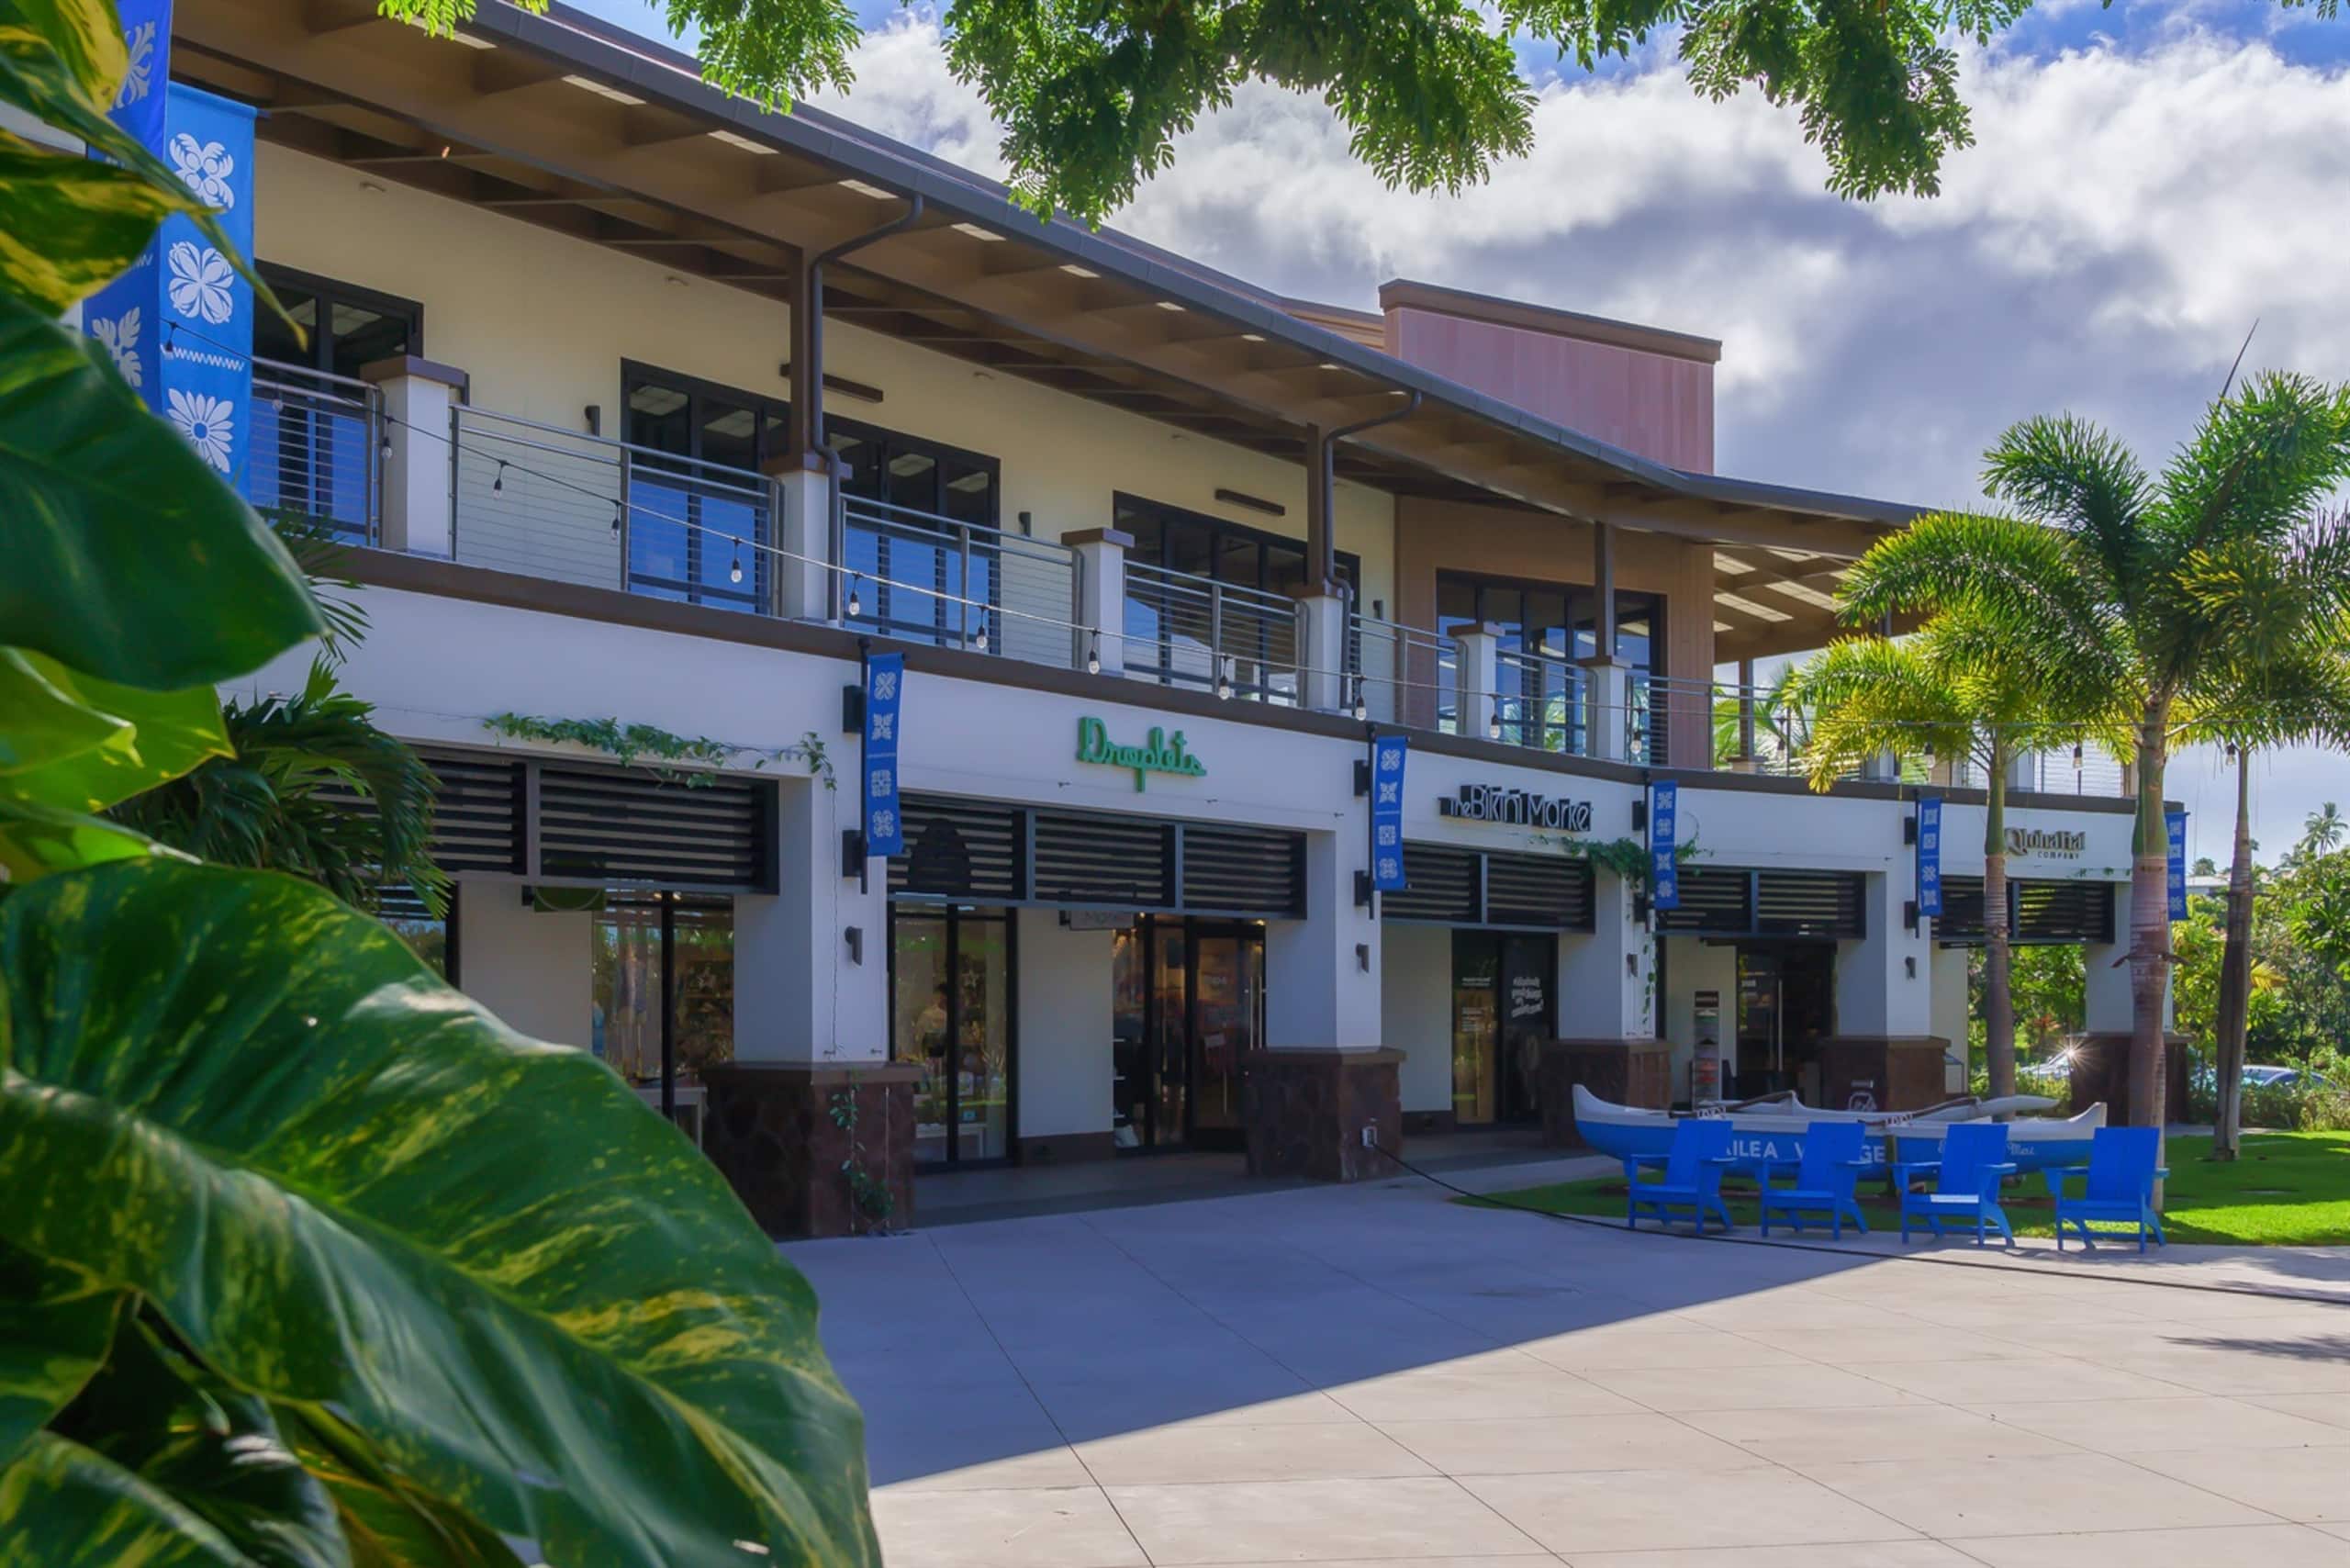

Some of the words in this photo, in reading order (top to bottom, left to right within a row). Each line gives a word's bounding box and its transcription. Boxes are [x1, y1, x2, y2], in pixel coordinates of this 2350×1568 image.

[1077, 716, 1207, 792] Droplets
[1438, 797, 1472, 817] The
[1461, 784, 1527, 824] Bikini
